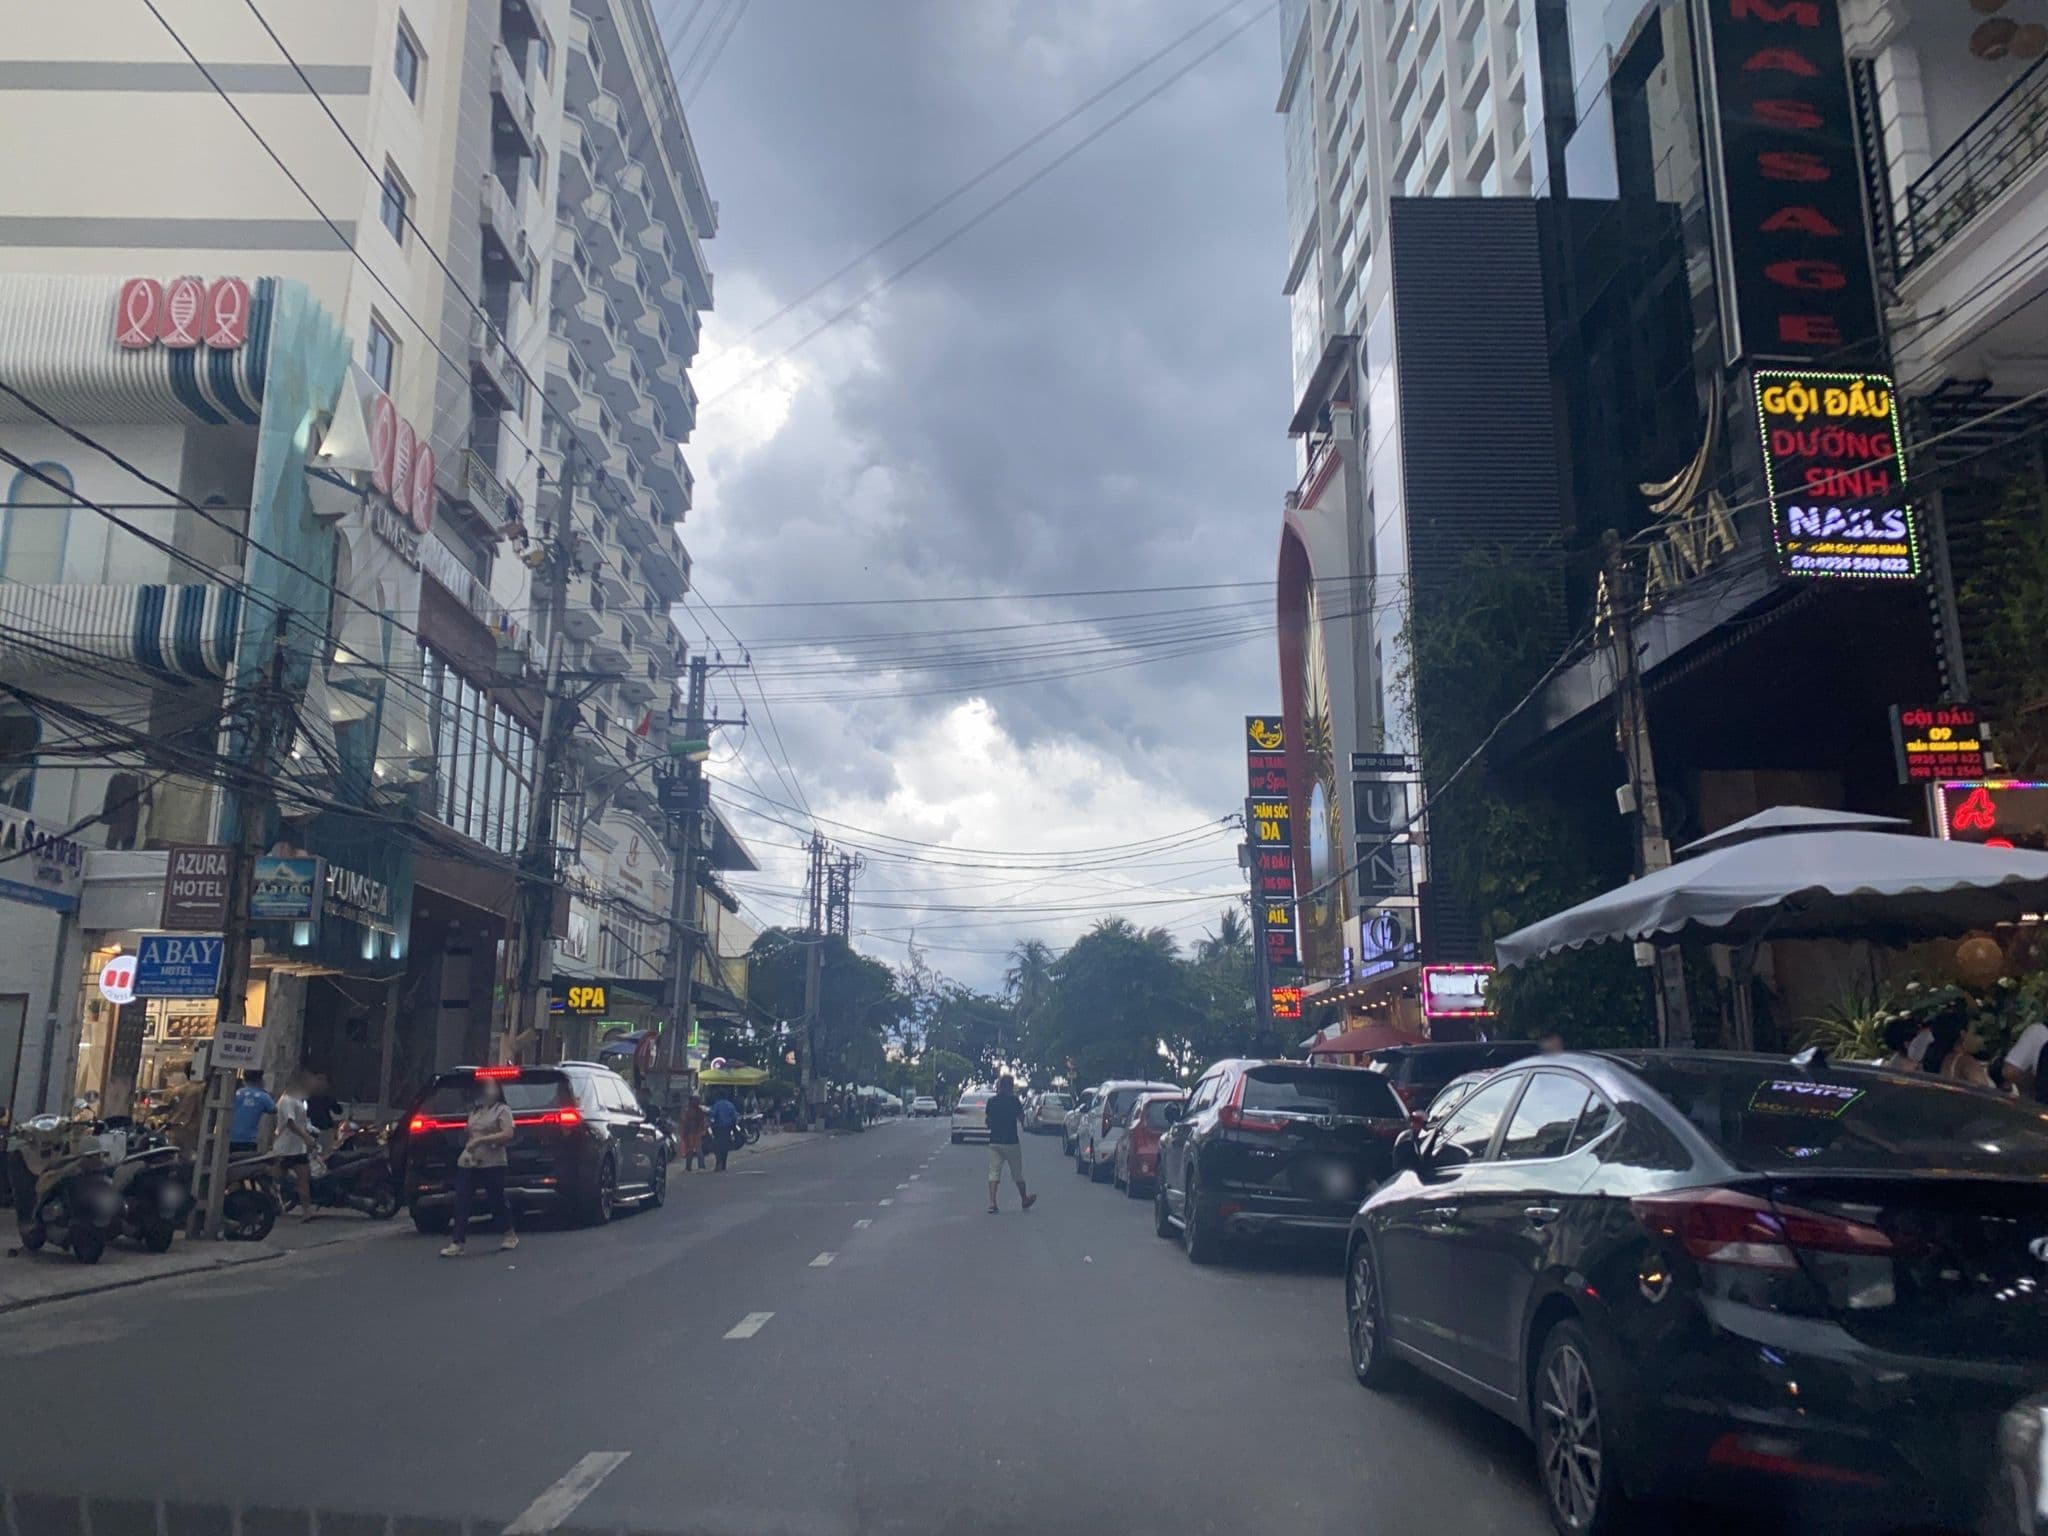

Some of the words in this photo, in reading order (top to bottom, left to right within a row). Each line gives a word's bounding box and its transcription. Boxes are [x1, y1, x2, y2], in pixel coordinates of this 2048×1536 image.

[1729, 0, 1847, 347] MASSAGE
[1763, 379, 1819, 423] GỘI
[1805, 465, 1889, 497] SINH
[1929, 727, 1953, 741] 09
[1260, 821, 1281, 841] DA
[175, 853, 228, 876] AZURA
[172, 880, 224, 897] HOTEL
[329, 863, 389, 917] YUMSEA
[568, 987, 606, 1009] SPA
